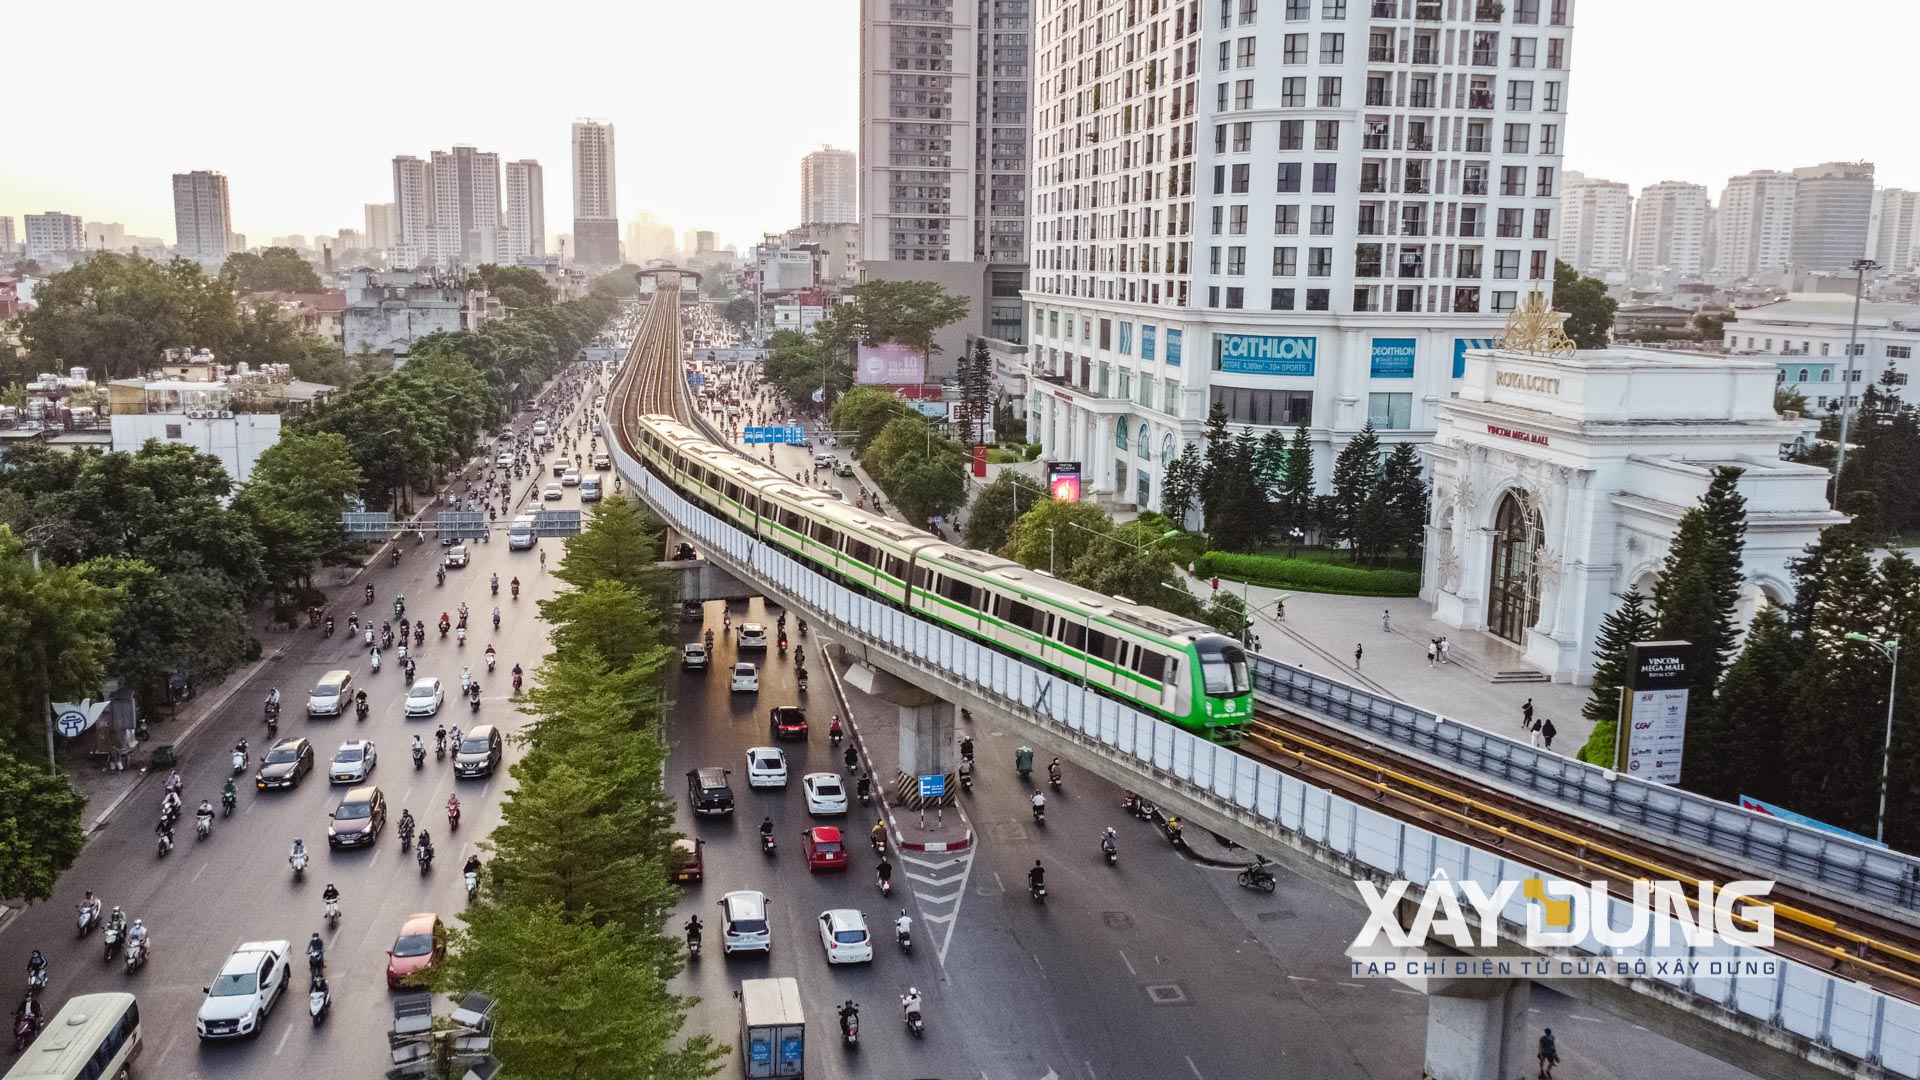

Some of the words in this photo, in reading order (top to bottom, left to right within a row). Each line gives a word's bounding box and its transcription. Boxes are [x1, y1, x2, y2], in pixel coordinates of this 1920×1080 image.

[1221, 335, 1313, 359] ECATHLON
[1281, 364, 1306, 372] SPORTS
[1487, 425, 1511, 437] VINCOM
[1512, 430, 1530, 441] MEGA
[1531, 434, 1549, 446] MALL
[1648, 657, 1680, 665] VINCOM
[1641, 664, 1664, 672] MEGA
[1664, 663, 1686, 671] MALL
[1635, 721, 1652, 730] CGV
